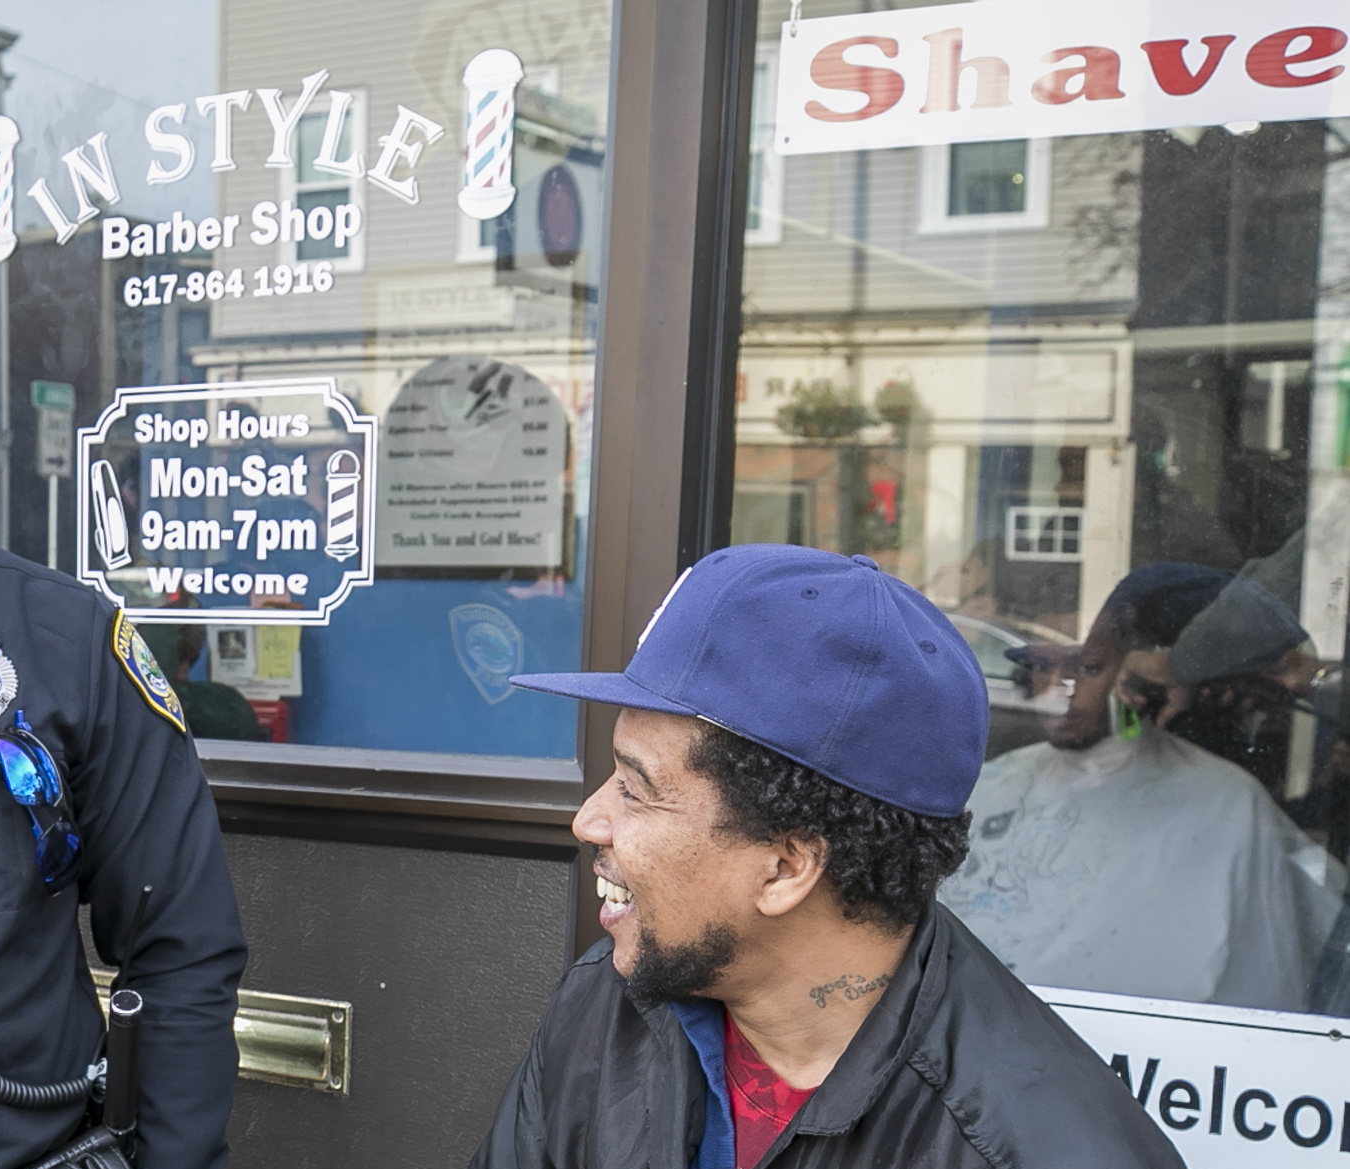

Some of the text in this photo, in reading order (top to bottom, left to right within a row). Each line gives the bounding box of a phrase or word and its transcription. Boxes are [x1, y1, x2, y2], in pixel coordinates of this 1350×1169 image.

[804, 27, 1348, 123] Shave
[27, 69, 446, 245] IN STYLE
[102, 199, 362, 259] Barber Shop
[123, 262, 334, 307] 617-864 1916
[134, 410, 310, 448] Shop Hours
[150, 455, 308, 498] Mon-Sat
[141, 509, 317, 560] 9am-7pm
[147, 567, 309, 595] Welcome
[1110, 1054, 1350, 1153] elco
